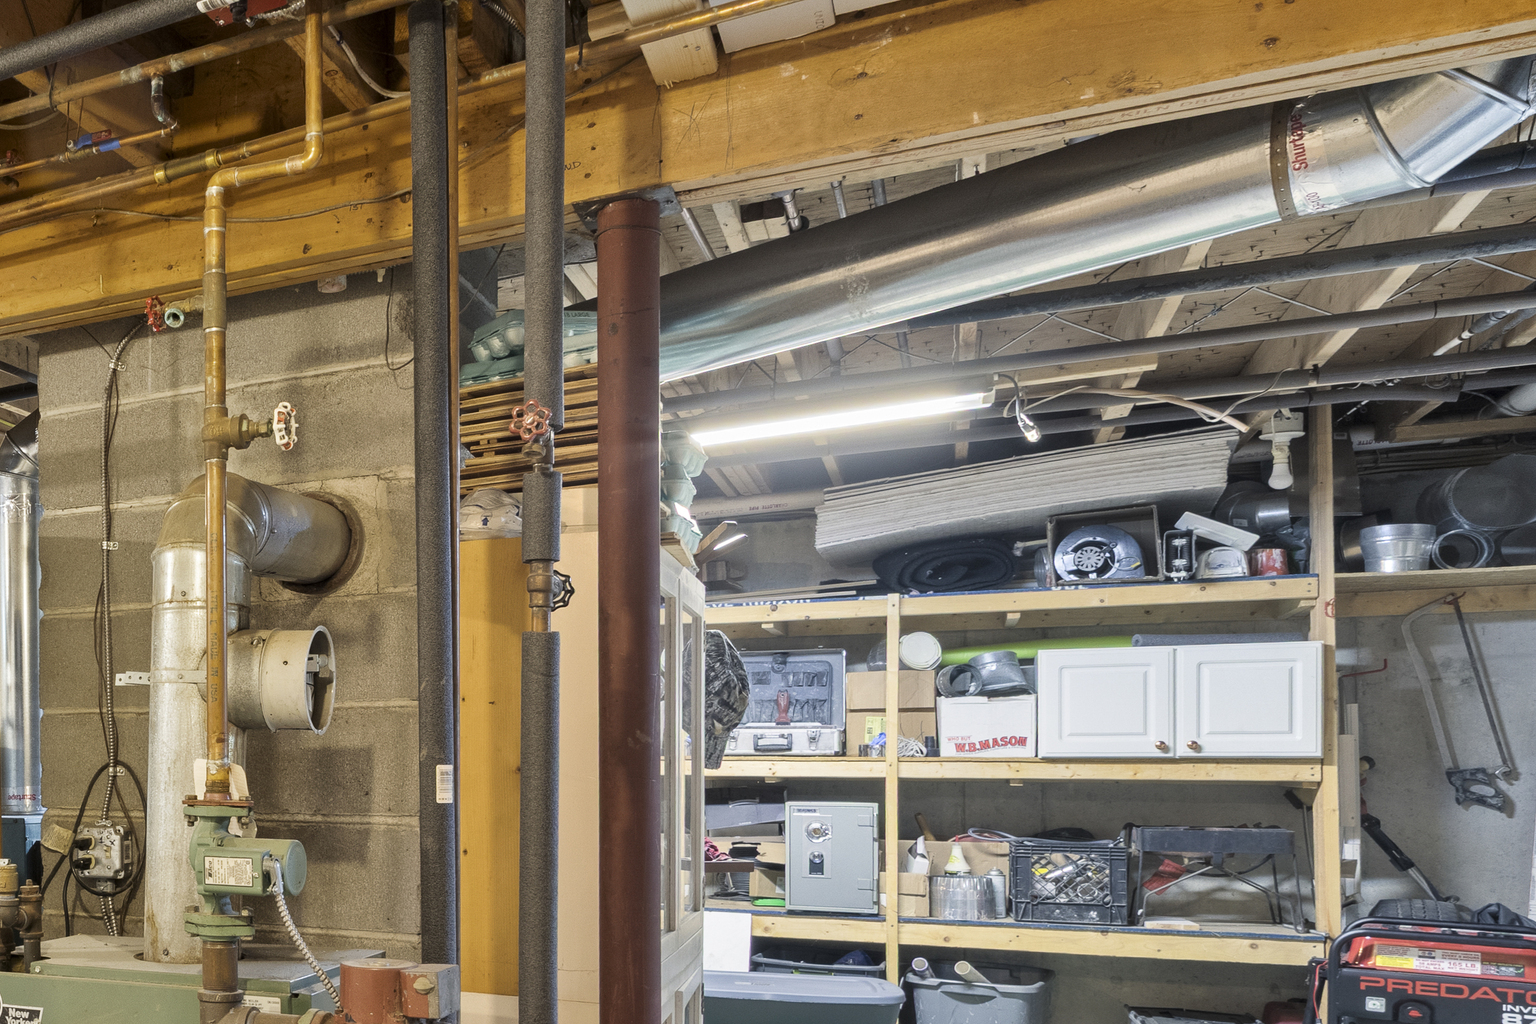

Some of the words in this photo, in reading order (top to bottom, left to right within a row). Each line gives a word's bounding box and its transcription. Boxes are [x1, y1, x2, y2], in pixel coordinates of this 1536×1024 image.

[1290, 113, 1308, 172] Shurtape
[954, 735, 1028, 753] W.B.MASON
[8, 1007, 30, 1019] New
